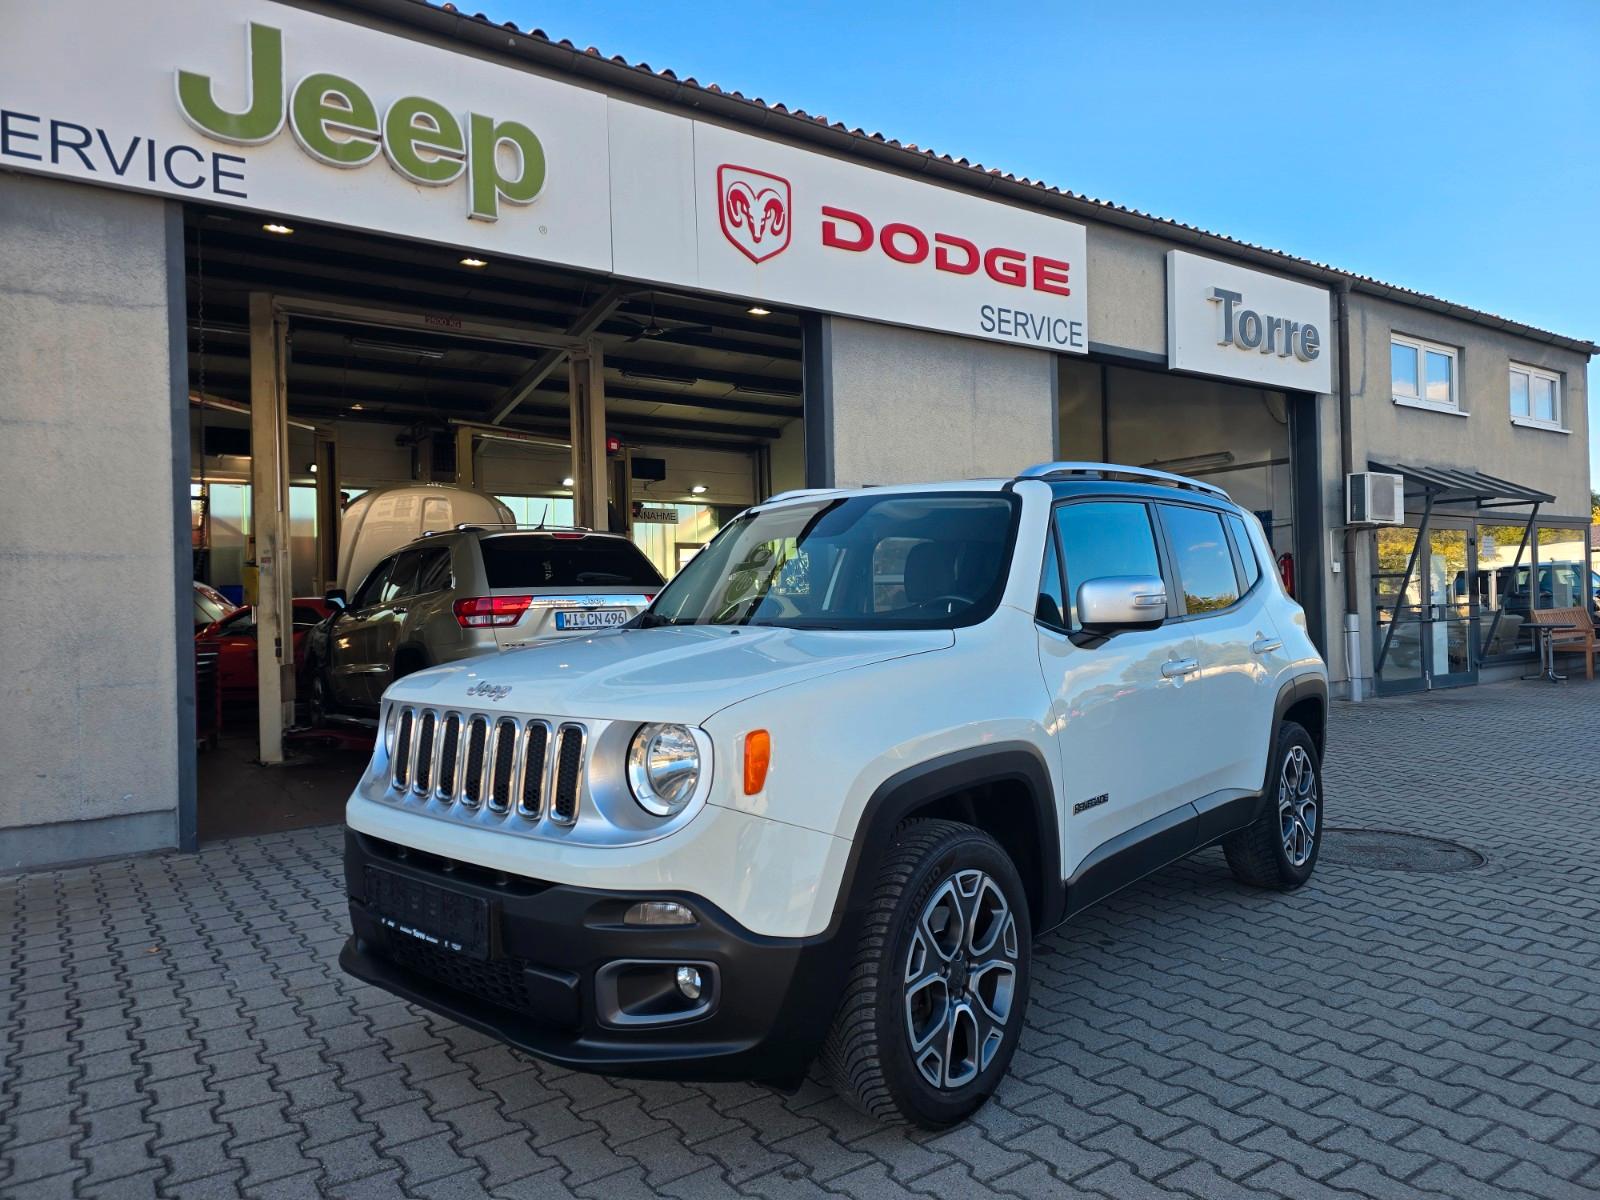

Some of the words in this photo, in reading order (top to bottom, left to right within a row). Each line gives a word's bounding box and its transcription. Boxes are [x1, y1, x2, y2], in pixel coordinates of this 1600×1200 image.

[174, 21, 548, 222] Jeep
[1, 109, 248, 199] ERVICE
[822, 206, 1071, 296] DODGE
[980, 305, 1083, 347] SERVICE
[1207, 286, 1320, 361] Torre
[638, 511, 676, 521] NNAHME
[565, 613, 579, 626] WI
[588, 612, 603, 625] CN
[604, 612, 625, 625] 496
[467, 680, 512, 701] Jeep
[1073, 793, 1109, 816] RENEGADE
